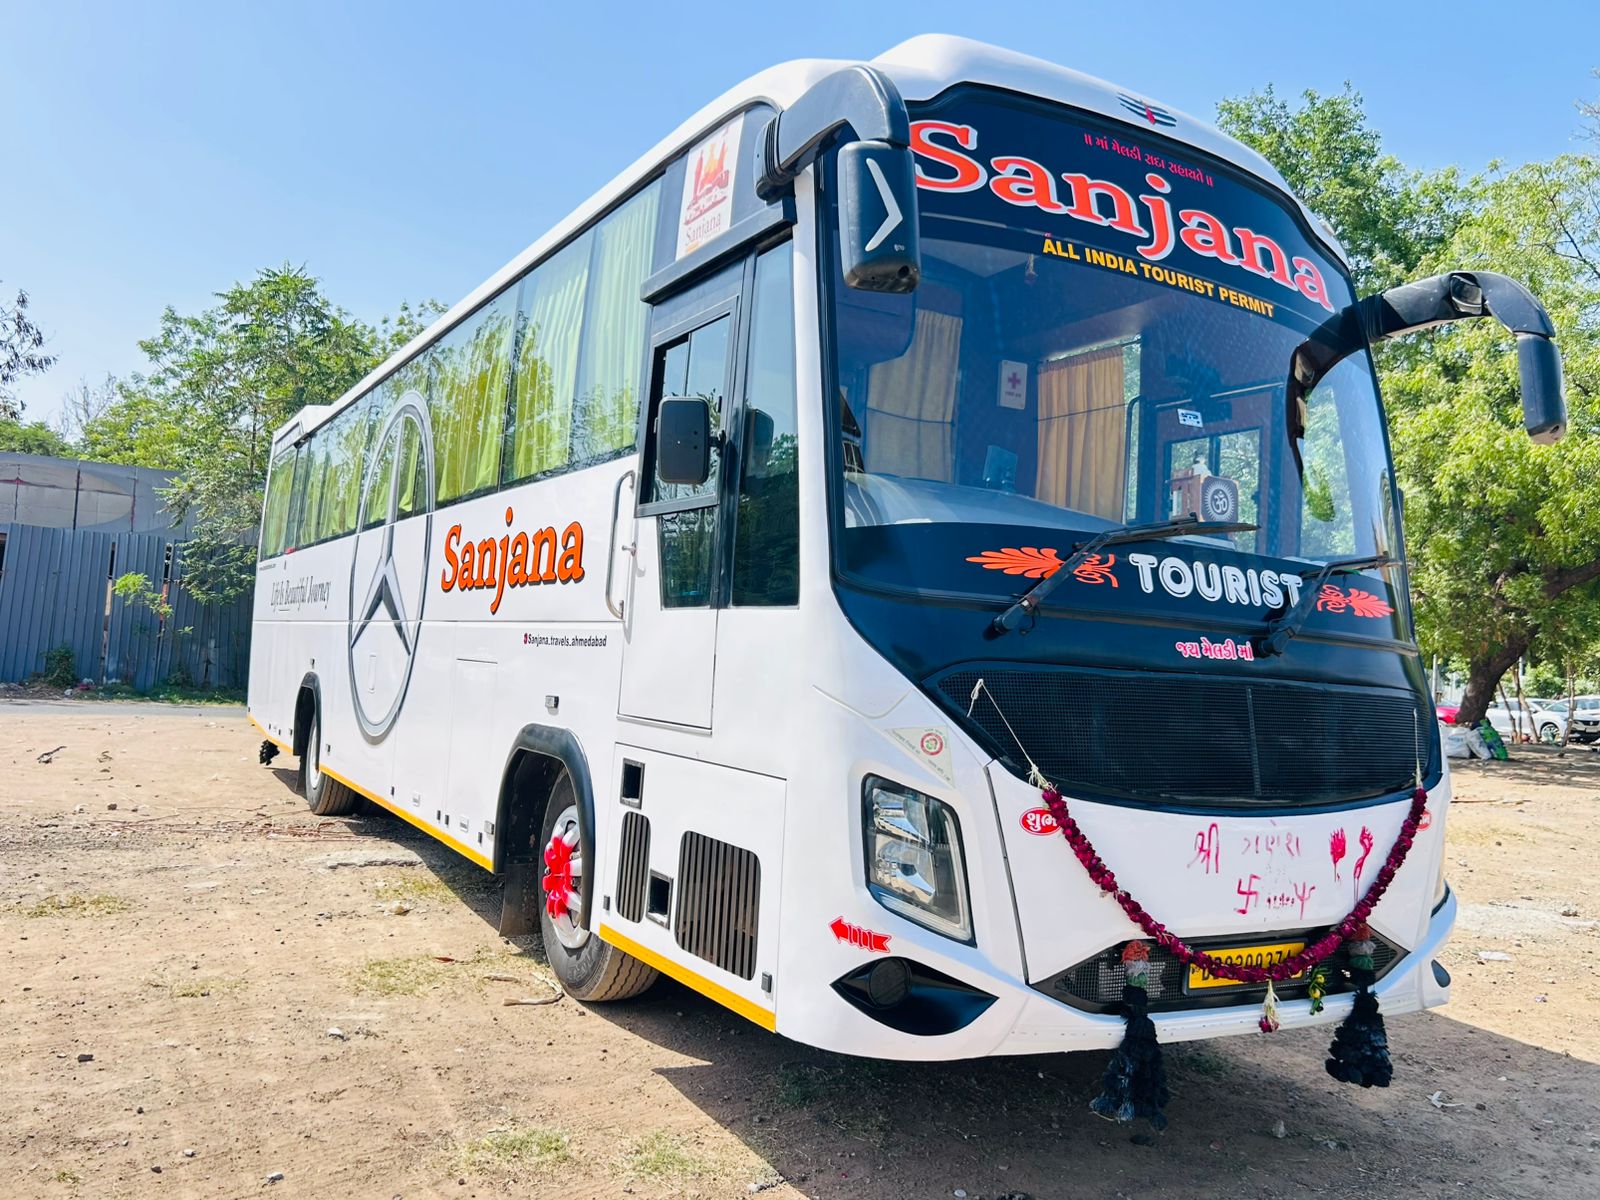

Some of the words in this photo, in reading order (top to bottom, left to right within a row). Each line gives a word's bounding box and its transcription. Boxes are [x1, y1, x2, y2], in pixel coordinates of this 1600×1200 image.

[686, 212, 721, 243] Sanjana
[908, 119, 1335, 312] Sanjana
[1043, 239, 1080, 260] ALL
[1084, 247, 1138, 275] INDIA
[1140, 262, 1214, 297] TOURIST
[1218, 286, 1274, 318] PERMIT
[441, 506, 585, 615] Sanjana
[1129, 553, 1303, 609] TOURIST
[1175, 641, 1201, 659] જય
